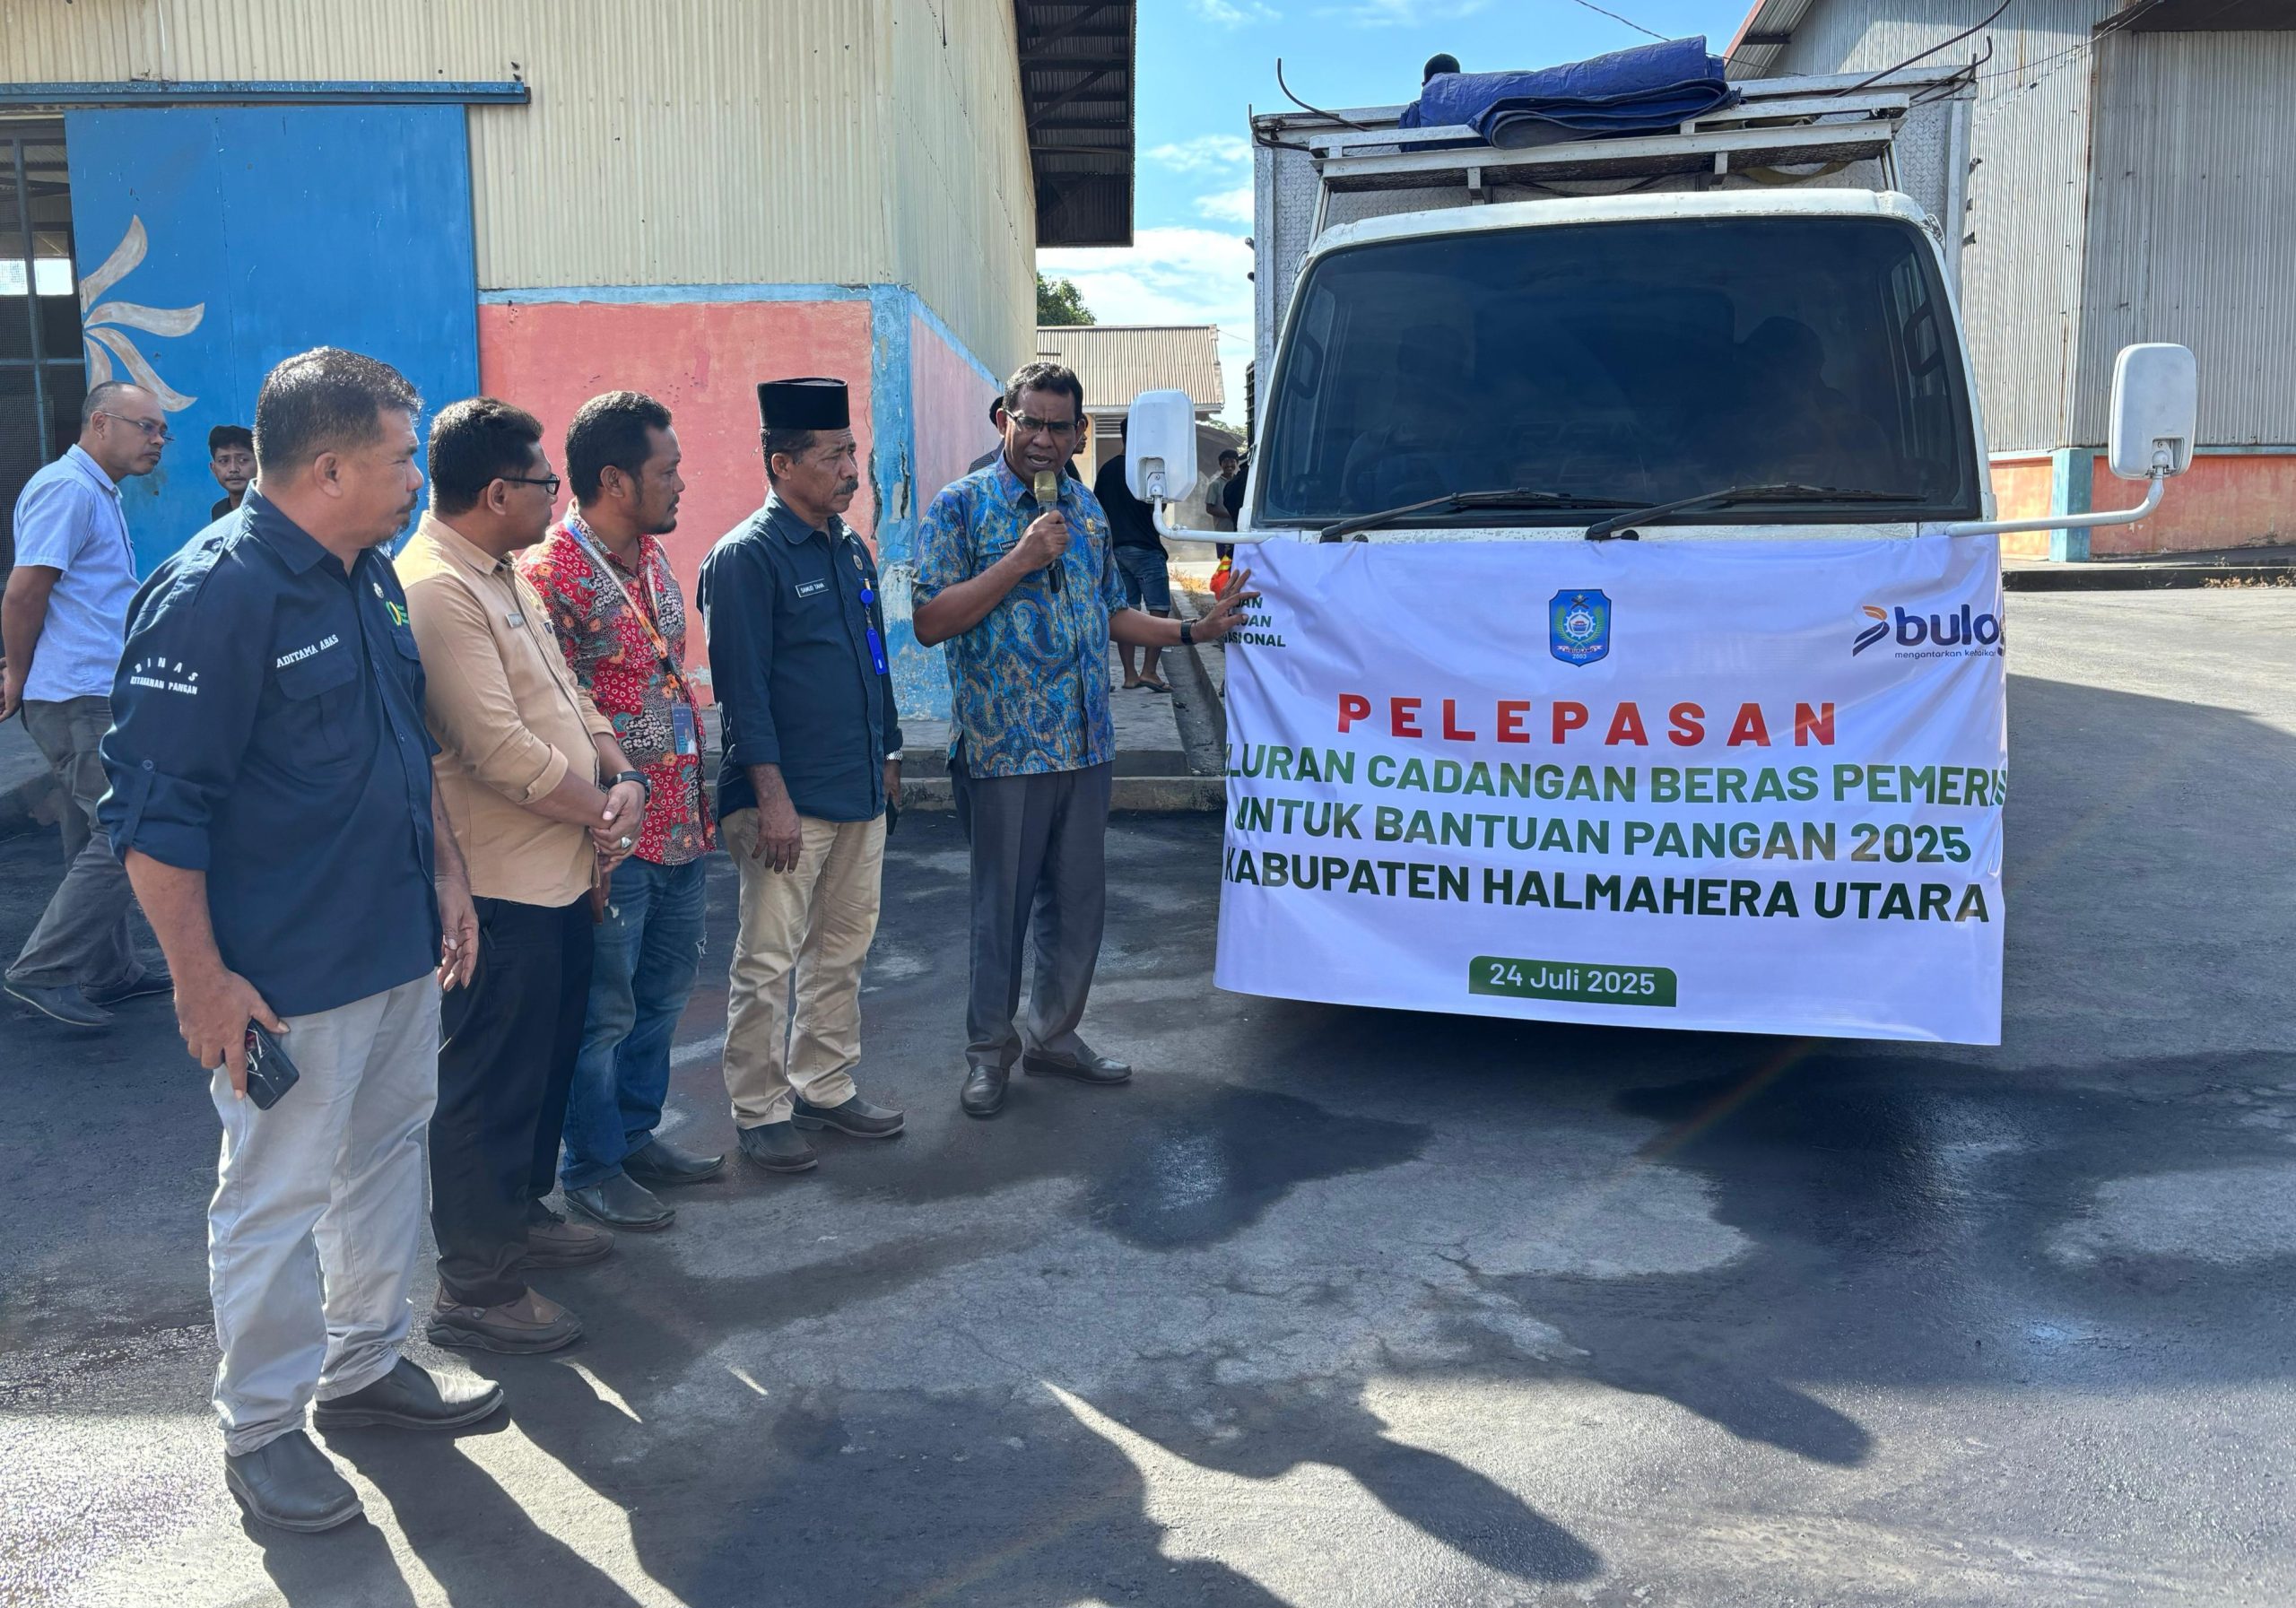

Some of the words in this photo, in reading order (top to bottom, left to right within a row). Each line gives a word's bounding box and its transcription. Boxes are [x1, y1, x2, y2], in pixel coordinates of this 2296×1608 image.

[276, 644, 318, 668] ADITAMA
[319, 633, 339, 650] ABAS
[1894, 649, 1961, 659] mengantarkan
[135, 656, 198, 682] DINAS
[168, 682, 198, 695] PANGAN
[1337, 693, 1835, 747] PELEPASAN
[1225, 743, 1355, 785] LURAN
[1367, 754, 1636, 803] CADANGAN
[1650, 766, 1819, 804] BERAS
[1234, 796, 1363, 840] UNTUK
[1374, 804, 1610, 855] BANTUAN
[1623, 821, 1836, 861] PANGAN
[1850, 822, 1971, 863] 2025
[1225, 846, 1469, 902] KABUPATEN
[1483, 867, 1799, 918] HALMAHERA
[1813, 881, 1989, 923] UTARA
[1490, 963, 1523, 987] 24
[1529, 967, 1579, 991] Juli
[1587, 969, 1656, 995] 2025
